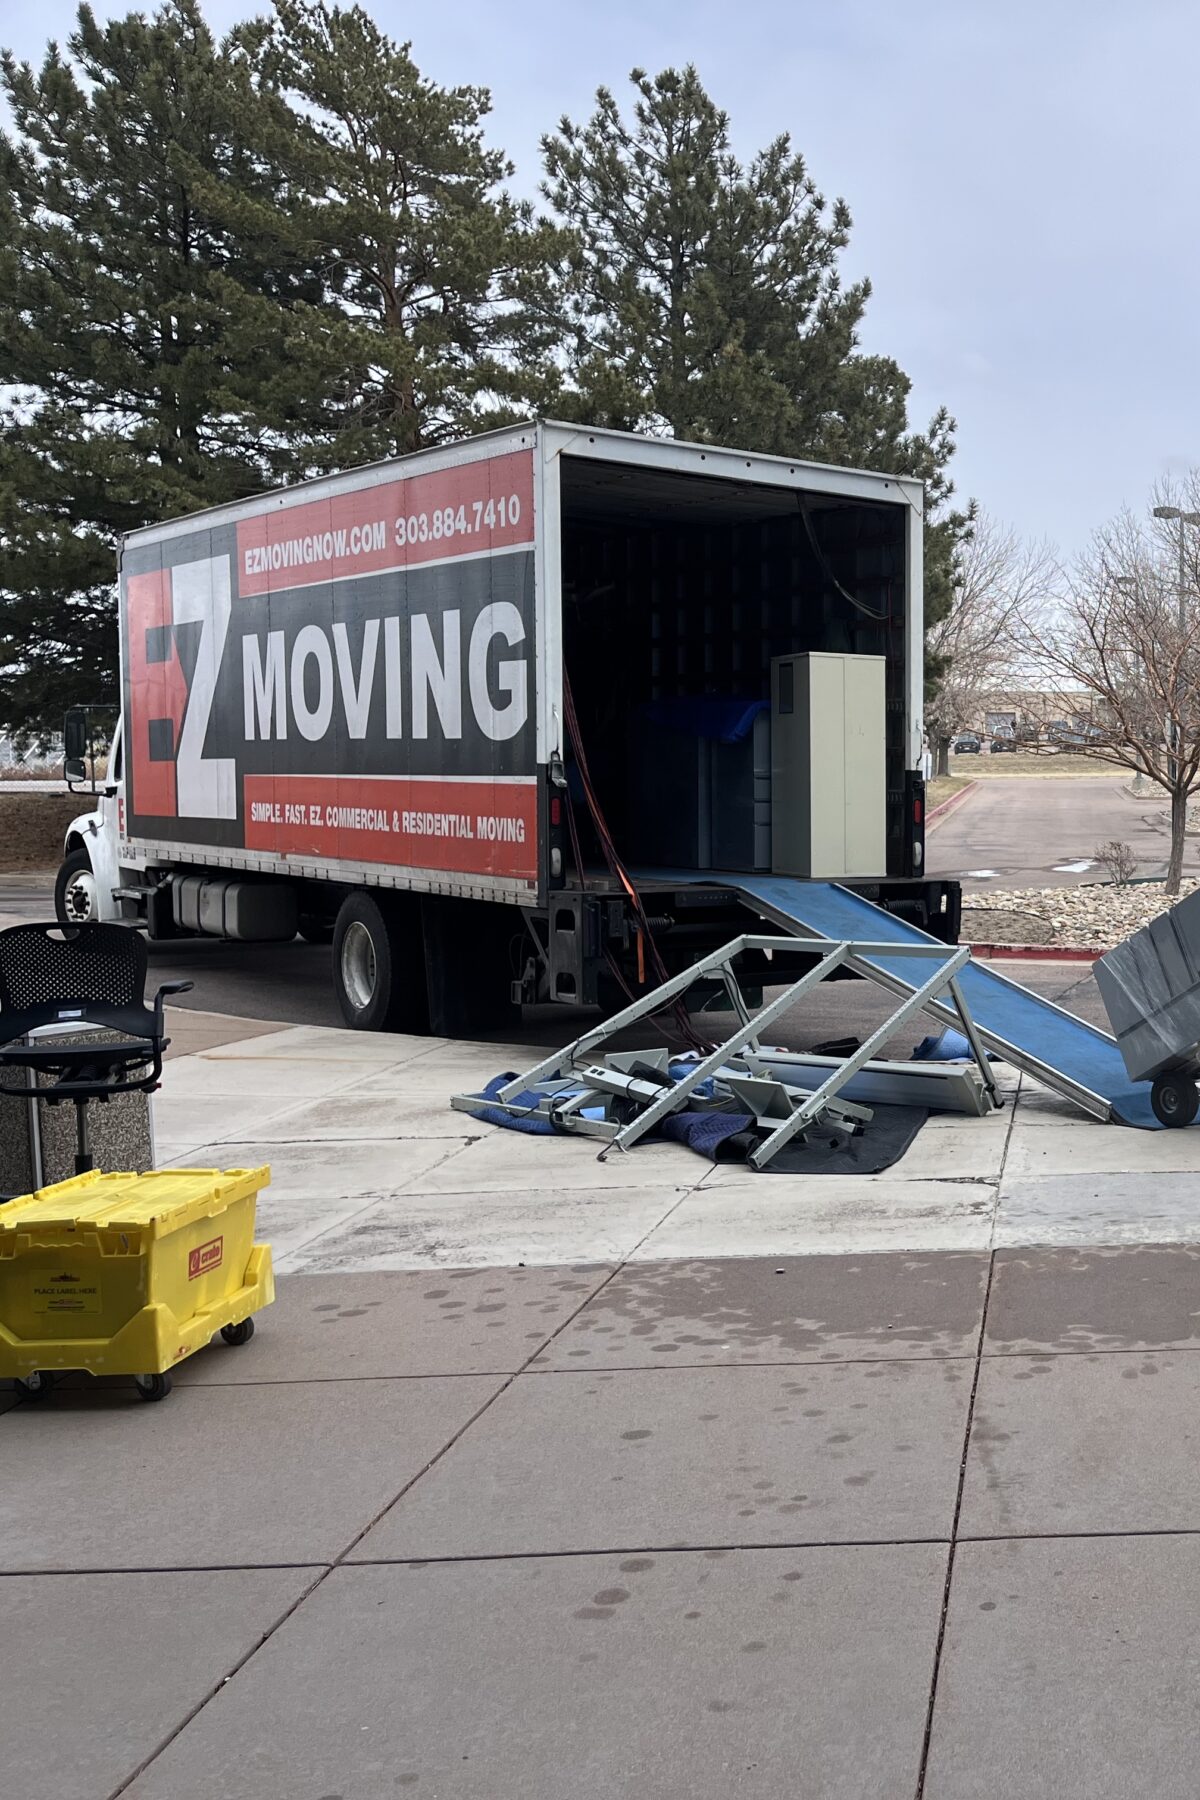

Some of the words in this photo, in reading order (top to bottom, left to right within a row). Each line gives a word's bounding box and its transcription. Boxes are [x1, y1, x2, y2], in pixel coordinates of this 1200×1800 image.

[244, 520, 386, 575] EZMOVINGNOW.COM
[394, 494, 521, 546] 303.884.7410
[126, 554, 237, 820] EZ
[241, 601, 528, 742] MOVING
[251, 802, 283, 823] SIMPLE.
[285, 804, 308, 825] FAST.
[309, 805, 324, 826] EZ.
[326, 806, 390, 832] COMMERCIAL
[392, 810, 400, 832] &
[402, 811, 473, 839] RESIDENTIAL
[477, 816, 525, 843] MOVING
